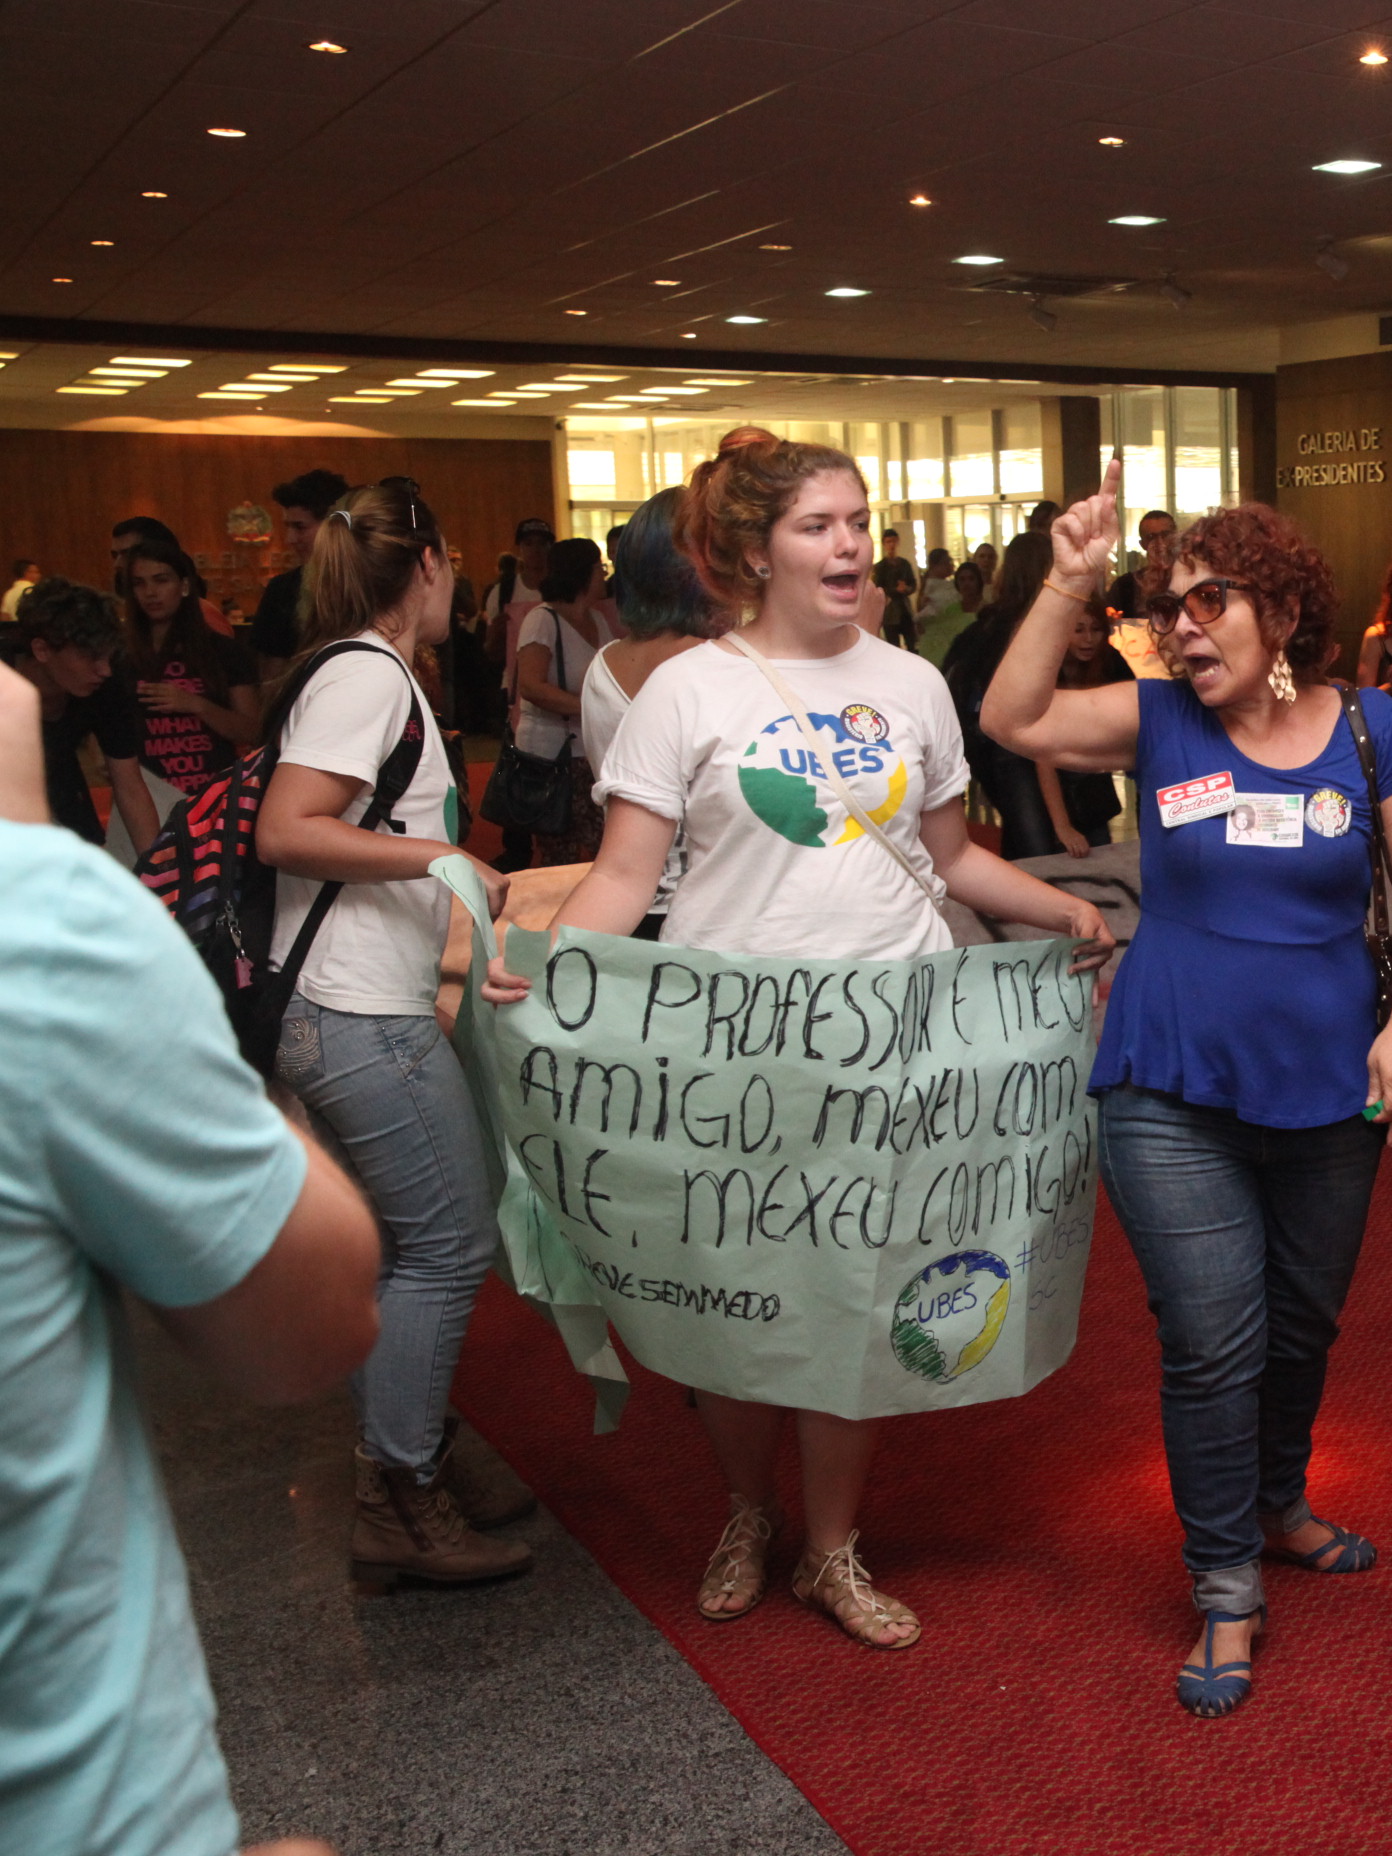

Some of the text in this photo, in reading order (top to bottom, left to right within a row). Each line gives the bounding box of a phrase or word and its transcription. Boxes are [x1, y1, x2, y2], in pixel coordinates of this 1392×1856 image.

[1298, 428, 1380, 455] GALERIA DE
[845, 705, 878, 717] GREVE!
[145, 716, 202, 735] WHAT
[144, 734, 214, 756] MAKES
[160, 755, 204, 774] YOU
[778, 747, 884, 780] UBES
[1163, 776, 1227, 802] CSP
[1313, 790, 1346, 805] GREVE!
[1168, 792, 1230, 818] Conlutas
[546, 947, 598, 1032] O
[641, 960, 935, 1071] PROFESSOR
[993, 950, 1086, 1044] MEU
[519, 1045, 1078, 1157] AMIGO, MEXEU COM
[681, 1164, 898, 1249] MEXEU
[918, 1113, 1092, 1247] COMIGO!
[917, 1280, 980, 1323] UBES
